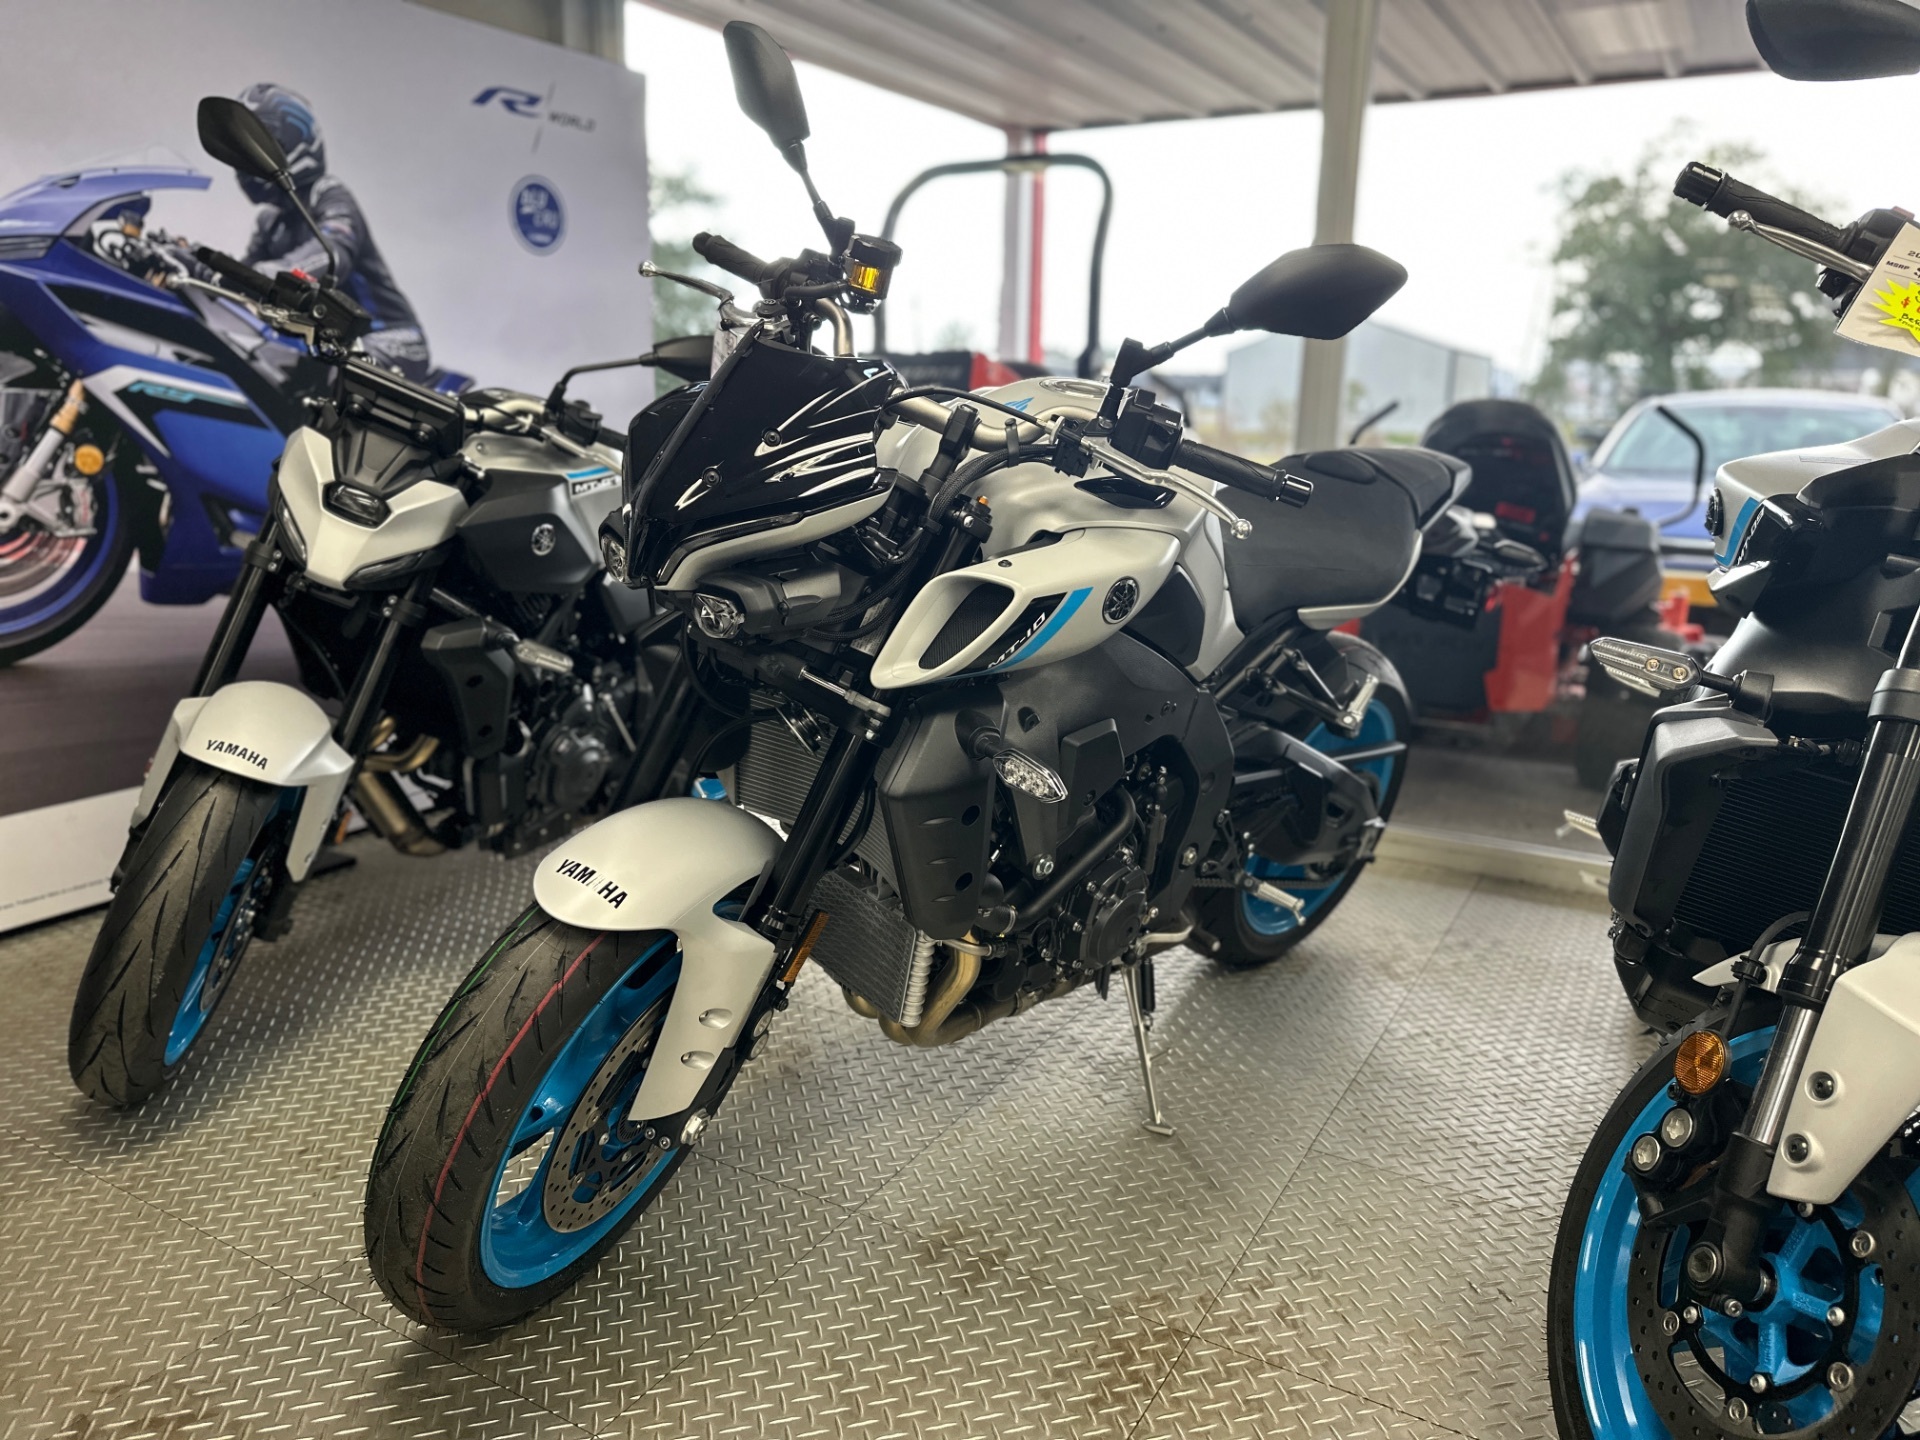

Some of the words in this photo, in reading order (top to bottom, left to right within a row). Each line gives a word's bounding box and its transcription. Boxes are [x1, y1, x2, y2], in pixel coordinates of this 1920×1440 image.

[549, 111, 596, 133] WORLD
[1886, 260, 1910, 271] MSRP
[988, 612, 1046, 669] MT-10
[206, 739, 268, 770] YAMAHA
